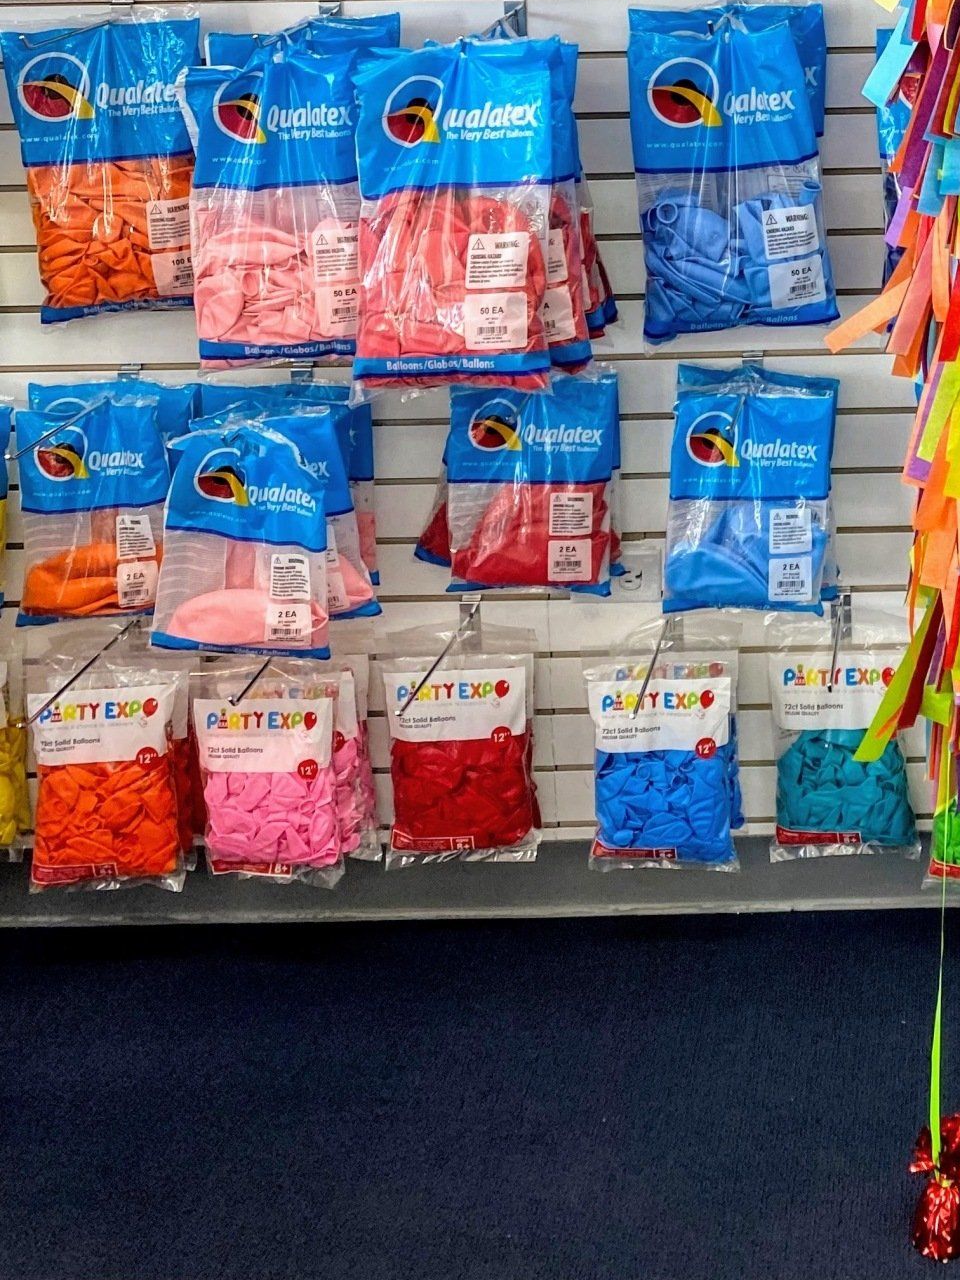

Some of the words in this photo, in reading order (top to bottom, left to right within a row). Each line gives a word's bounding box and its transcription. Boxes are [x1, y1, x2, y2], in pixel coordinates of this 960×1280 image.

[267, 102, 353, 133] Qualatex
[459, 129, 482, 142] Very
[482, 129, 506, 140] Best
[790, 268, 801, 277] 50
[801, 266, 813, 275] EA
[333, 289, 344, 298] 50
[345, 287, 358, 296] EA
[480, 306, 490, 315] 50
[491, 306, 505, 315] EA
[386, 358, 495, 372] Balloons/Globos/Ballons
[523, 423, 603, 446] Qualatex
[740, 438, 818, 462] Qualatex
[558, 546, 564, 554] 2
[564, 545, 577, 553] EA
[782, 563, 788, 571] 2
[788, 563, 801, 571] EA
[277, 609, 284, 618] 2
[284, 609, 298, 618] EA
[493, 731, 511, 743] 12"
[138, 753, 157, 765] 12"
[299, 764, 317, 776] 12"
